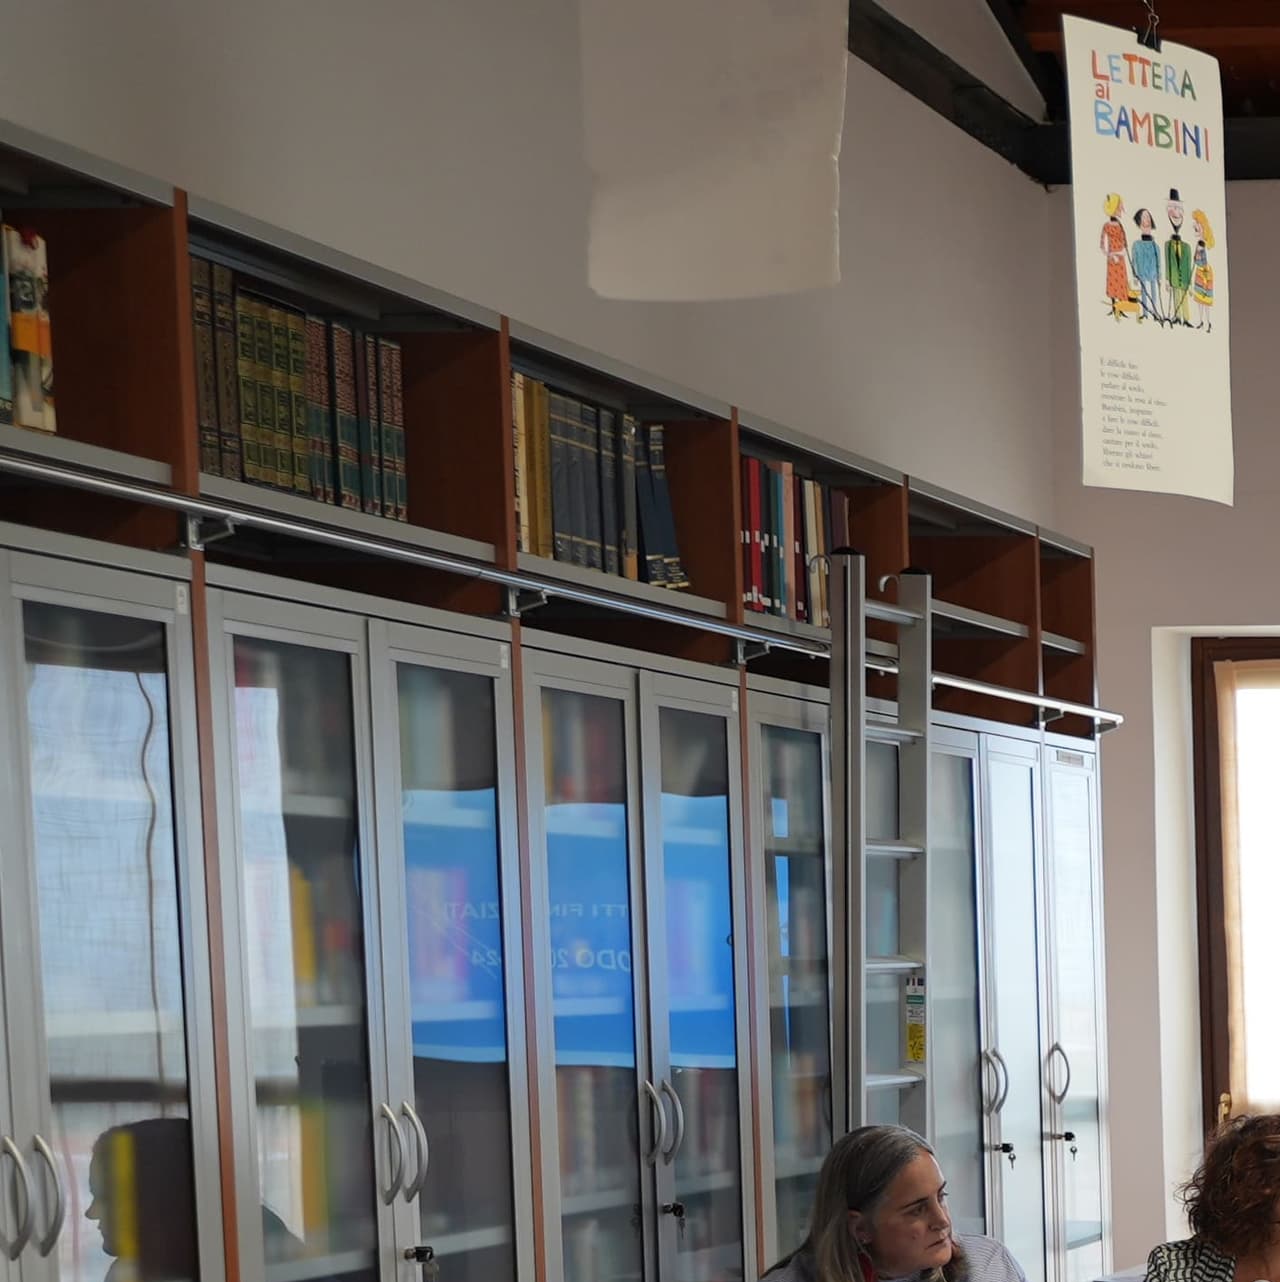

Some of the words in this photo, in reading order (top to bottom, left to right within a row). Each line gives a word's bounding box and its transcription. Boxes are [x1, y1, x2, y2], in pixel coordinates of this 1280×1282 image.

[1092, 49, 1197, 101] LETTERA
[1095, 83, 1110, 101] ai
[1094, 99, 1210, 163] BAMBINI
